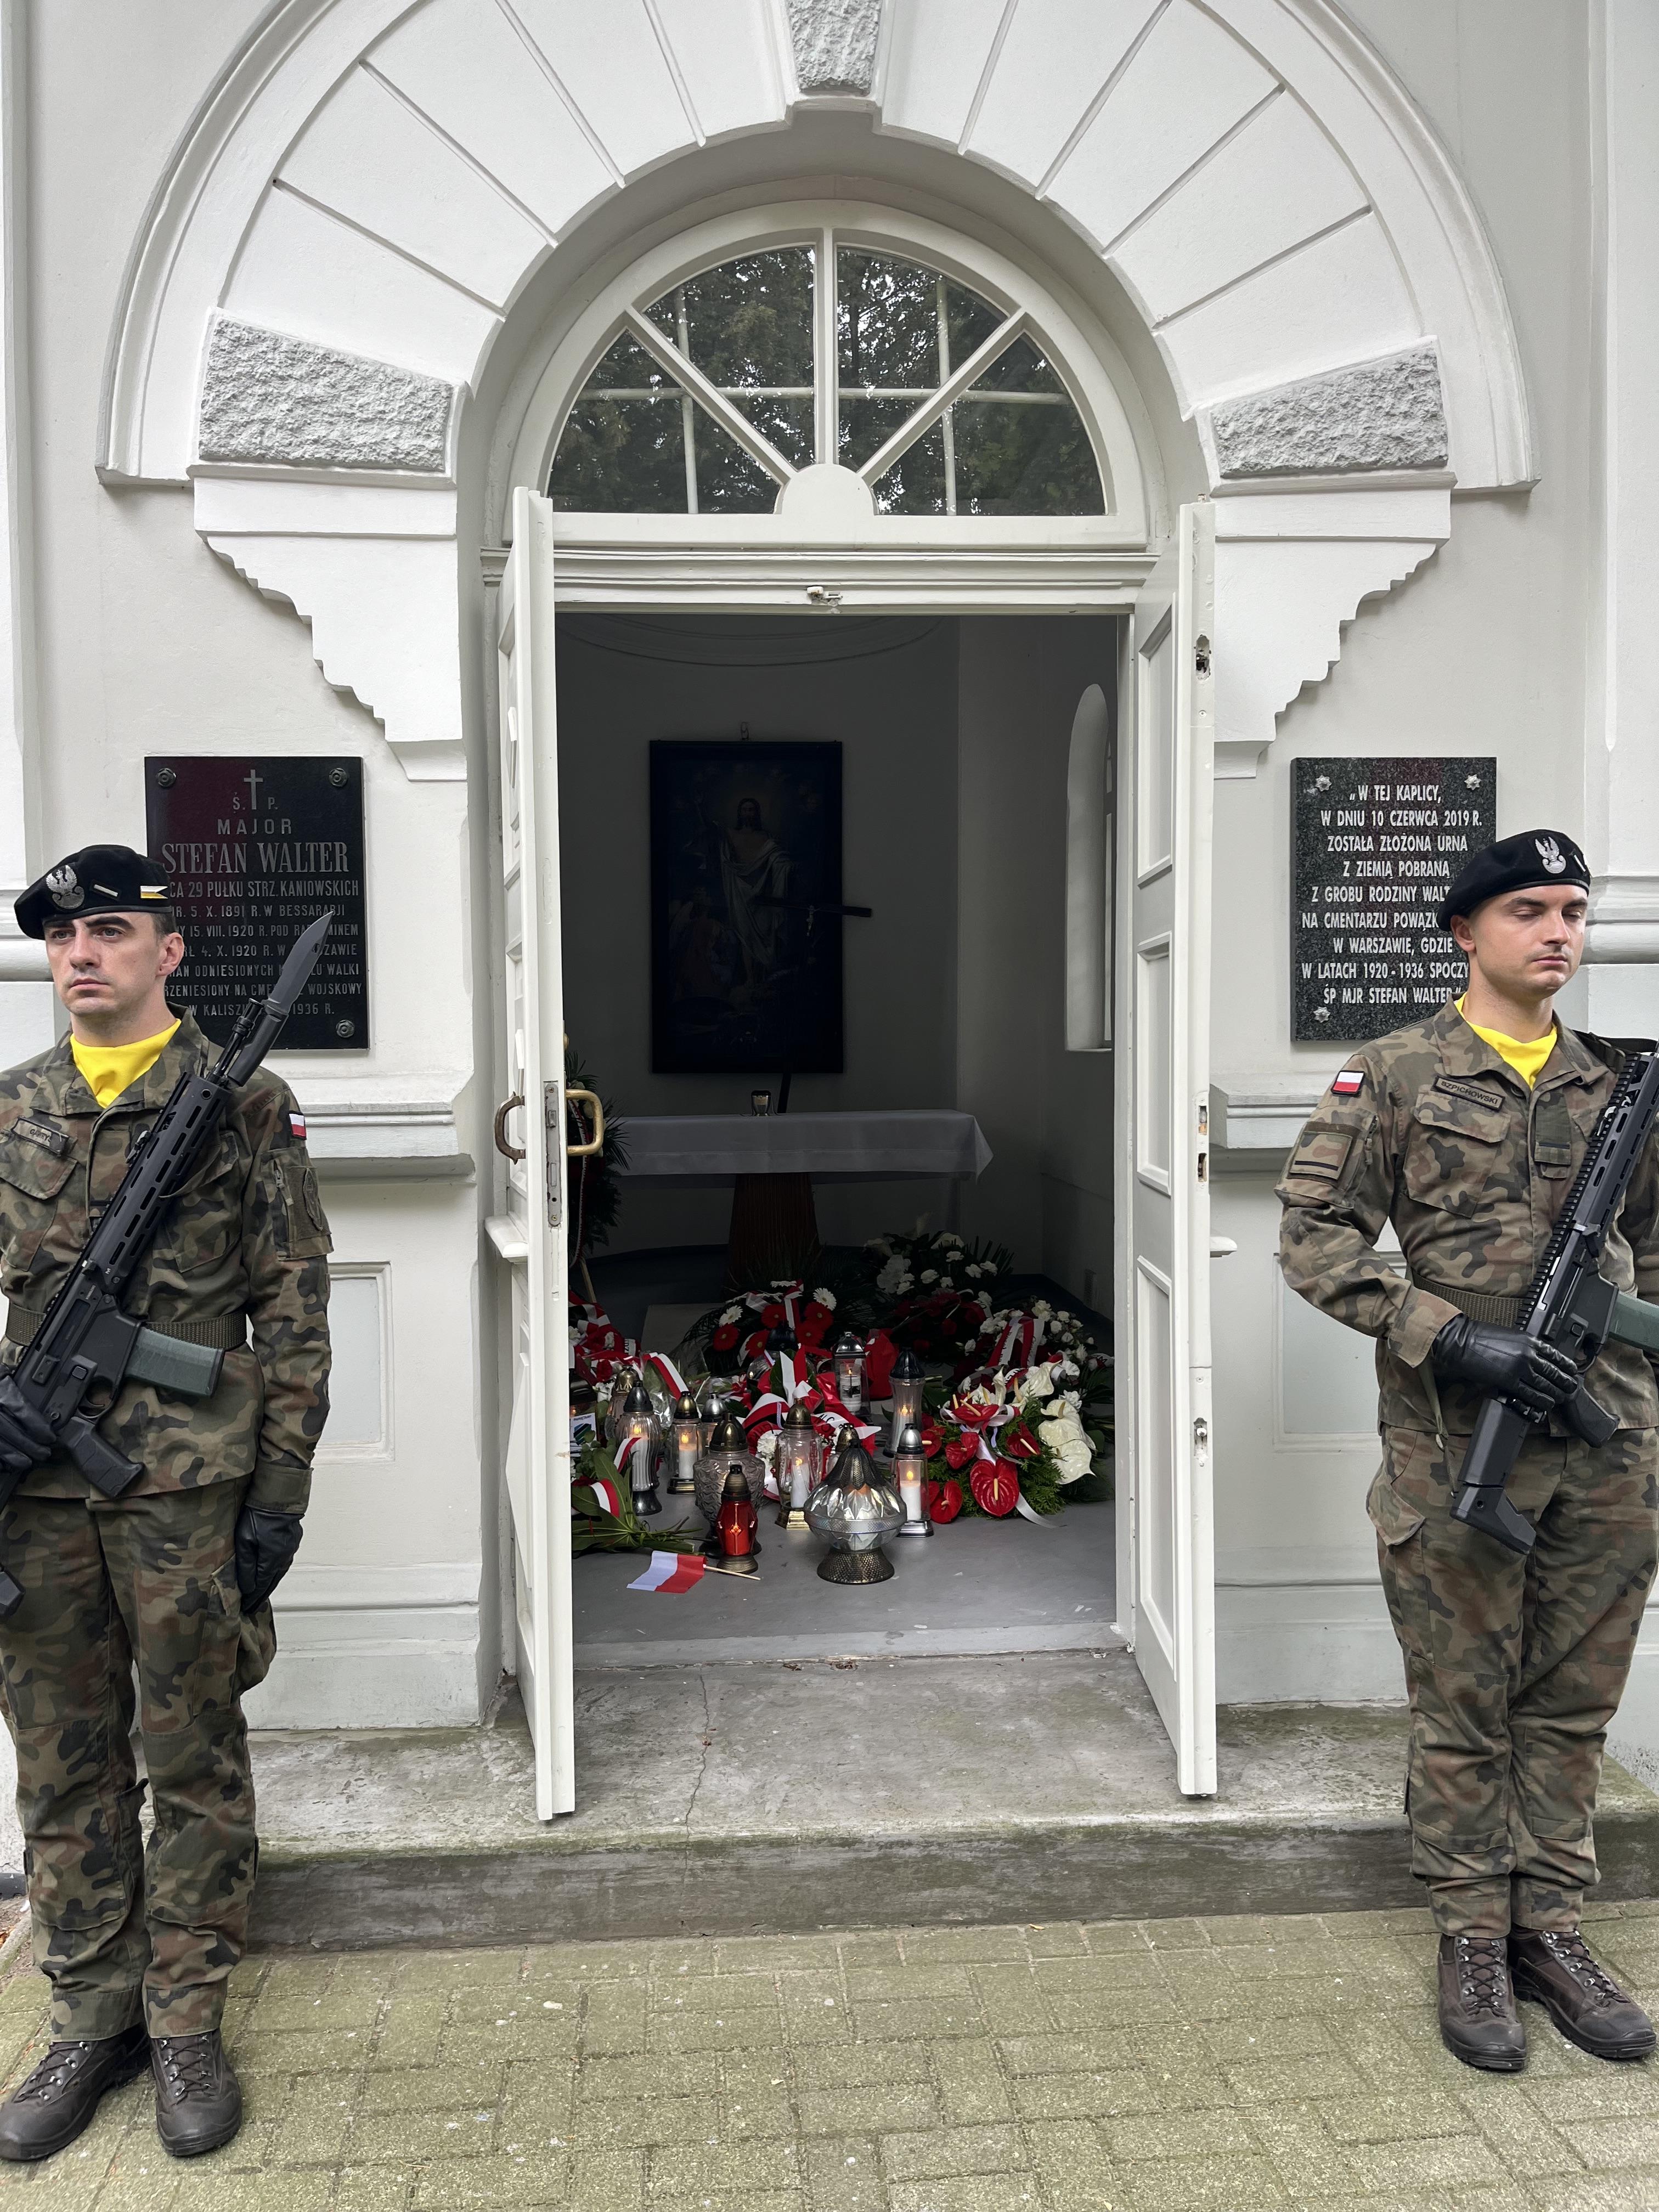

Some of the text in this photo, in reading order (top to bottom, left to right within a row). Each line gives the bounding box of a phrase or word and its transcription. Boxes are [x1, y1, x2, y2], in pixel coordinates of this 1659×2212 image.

[1374, 785, 1390, 801] TEJ
[1396, 785, 1441, 804] KAPLICY,
[217, 819, 292, 835] MAJOR
[1321, 810, 1482, 827] W DNIU 10 CZERWCA 2019 R.
[1327, 832, 1468, 852] ZOSTAŁA ZŁOŻONA URNA
[162, 842, 349, 873] STEFAN WALTER
[1343, 860, 1450, 879] Z ZIEMIĄ POBRANĄ
[188, 881, 202, 898] 29
[207, 881, 243, 898] PUŁKU
[248, 881, 279, 897] STRZ.
[280, 880, 359, 897] KANIOWSKICH
[1311, 886, 1319, 902] Z
[1325, 886, 1363, 902] GROBU
[1369, 886, 1417, 902] RODZINY
[190, 906, 202, 917] 5.
[206, 905, 217, 917] X.
[221, 905, 245, 917] 1891
[251, 905, 262, 917] R.
[263, 905, 273, 916] W
[1302, 912, 1318, 928] NA
[1324, 912, 1387, 928] CMENTARZU
[190, 926, 204, 937] 15.
[206, 925, 225, 937] VIII.
[228, 925, 254, 937] 1920
[259, 925, 268, 936] R.
[270, 924, 289, 936] POD
[201, 945, 212, 957] 4.
[217, 945, 228, 957] X.
[232, 945, 257, 957] 1920
[263, 945, 273, 956] R.
[277, 944, 286, 956] W
[1333, 937, 1453, 956] W WARSZAWIE, GDZIE
[195, 964, 273, 977] ODNIESIONYCH
[327, 963, 359, 975] WALKI
[1301, 963, 1312, 979] W
[1318, 963, 1357, 979] LATACH
[1363, 962, 1388, 979] 1920
[1399, 962, 1424, 978] 1936
[234, 984, 247, 996] NA
[307, 983, 362, 995] WOJSKOWY
[1323, 984, 1336, 1004] ŚP
[1342, 988, 1363, 1003] MJR
[1369, 988, 1407, 1003] STEFAN
[292, 1003, 319, 1014] 1936
[325, 1003, 335, 1014] R.
[1441, 1081, 1499, 1104] SZPICHOWSKI
